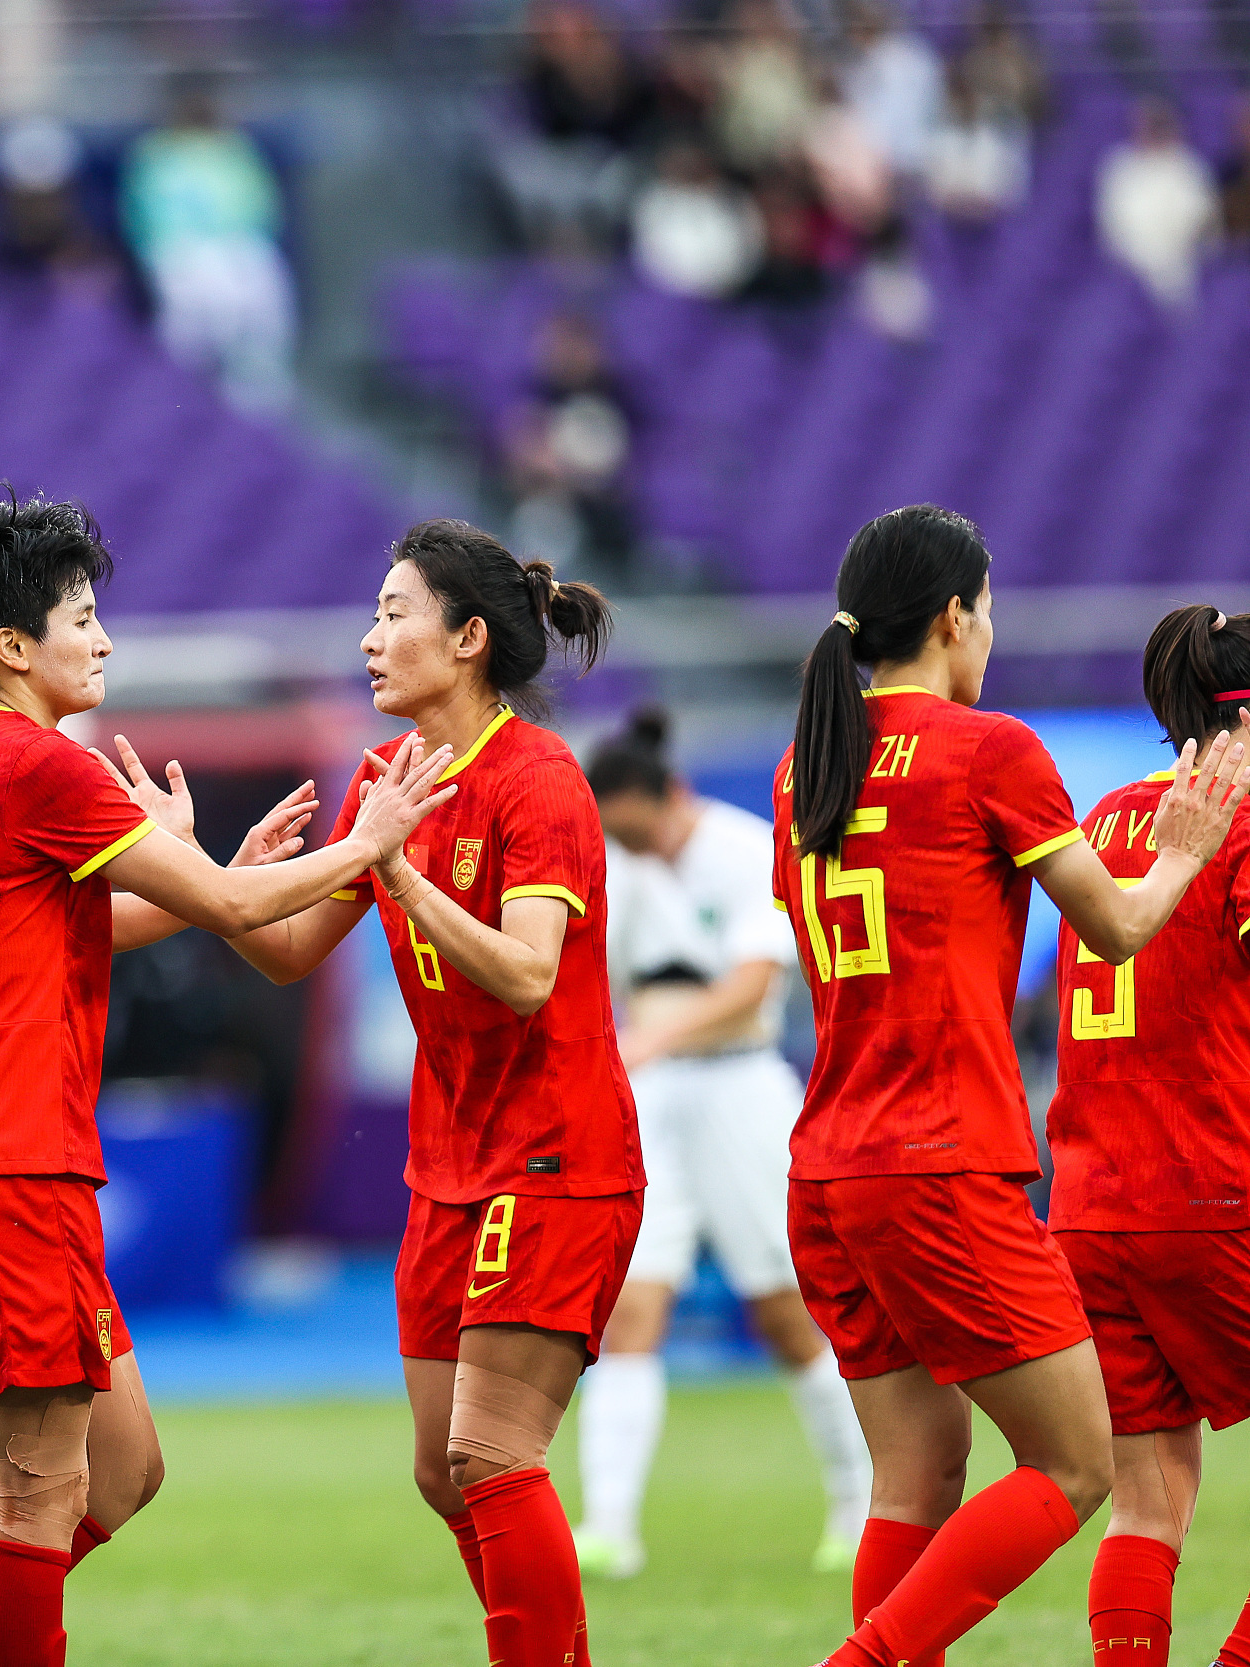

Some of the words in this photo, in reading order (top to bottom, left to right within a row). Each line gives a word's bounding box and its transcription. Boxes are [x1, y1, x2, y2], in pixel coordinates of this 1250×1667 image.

[459, 841, 480, 852] CFA
[790, 805, 891, 984] 15
[475, 1194, 516, 1272] 8
[1093, 1637, 1151, 1653] CFA
